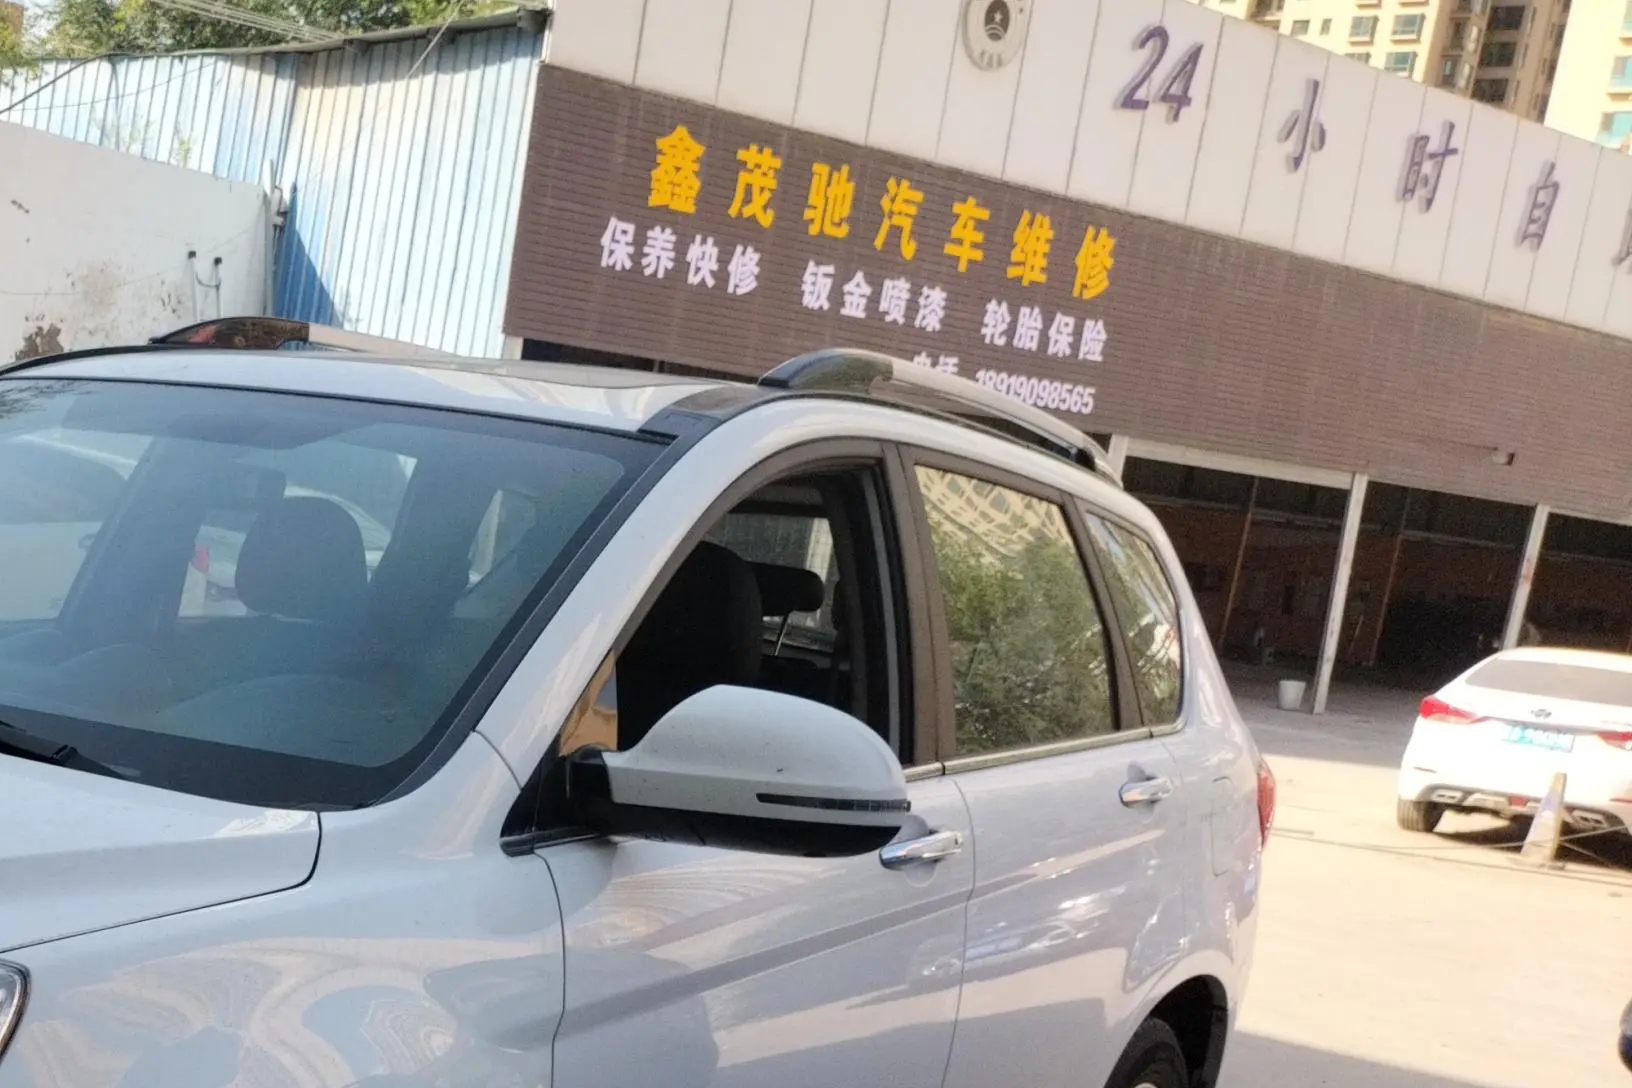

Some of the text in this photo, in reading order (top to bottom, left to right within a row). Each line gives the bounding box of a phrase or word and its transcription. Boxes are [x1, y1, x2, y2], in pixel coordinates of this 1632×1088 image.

[600, 215, 1108, 362] 保养快修 钣金喷漆 轮胎保险
[648, 125, 1116, 300] 鑫茂驰汽车维修
